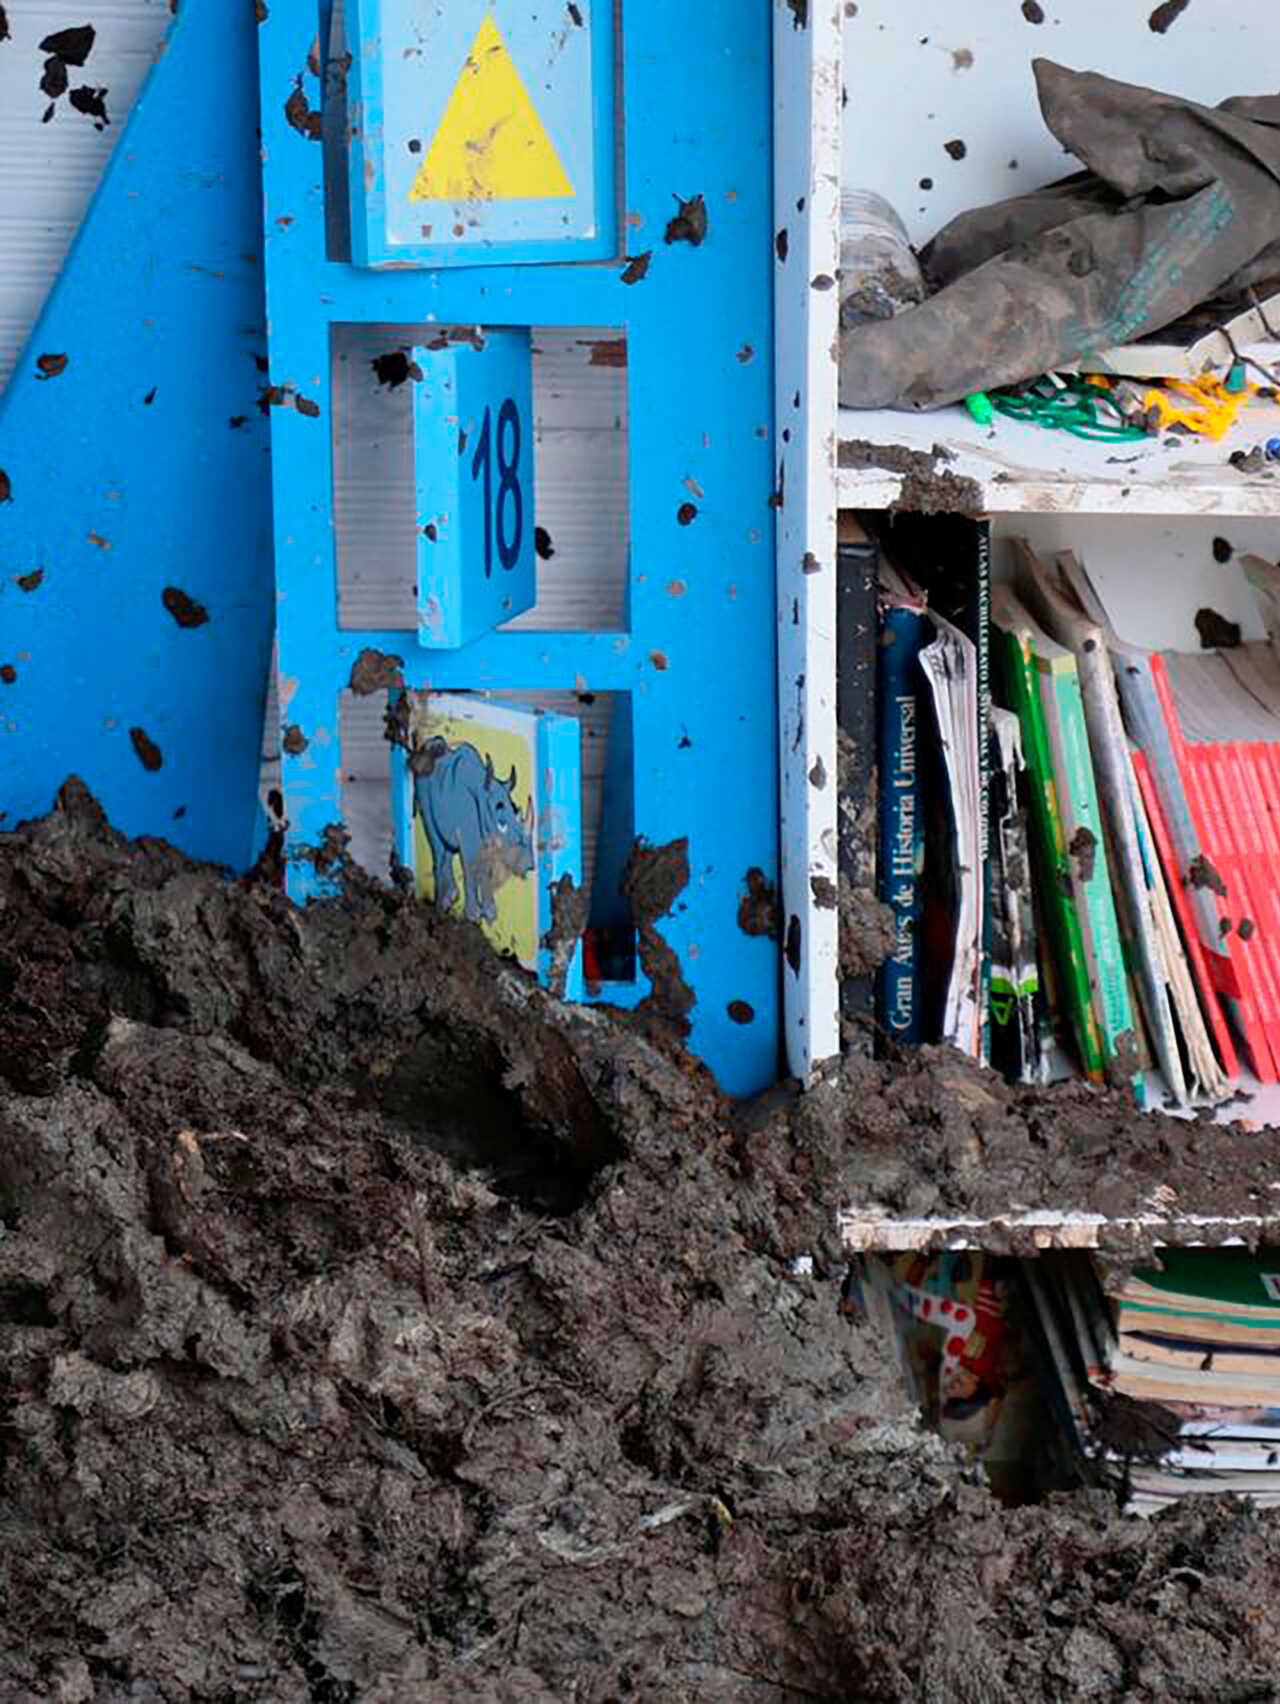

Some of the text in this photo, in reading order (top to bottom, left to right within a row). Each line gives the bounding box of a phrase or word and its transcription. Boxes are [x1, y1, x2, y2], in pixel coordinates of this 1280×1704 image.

[471, 395, 524, 580] 18
[892, 694, 917, 788] Universal
[891, 794, 916, 876] Historia
[892, 883, 915, 908] de
[889, 976, 914, 1030] Gran
